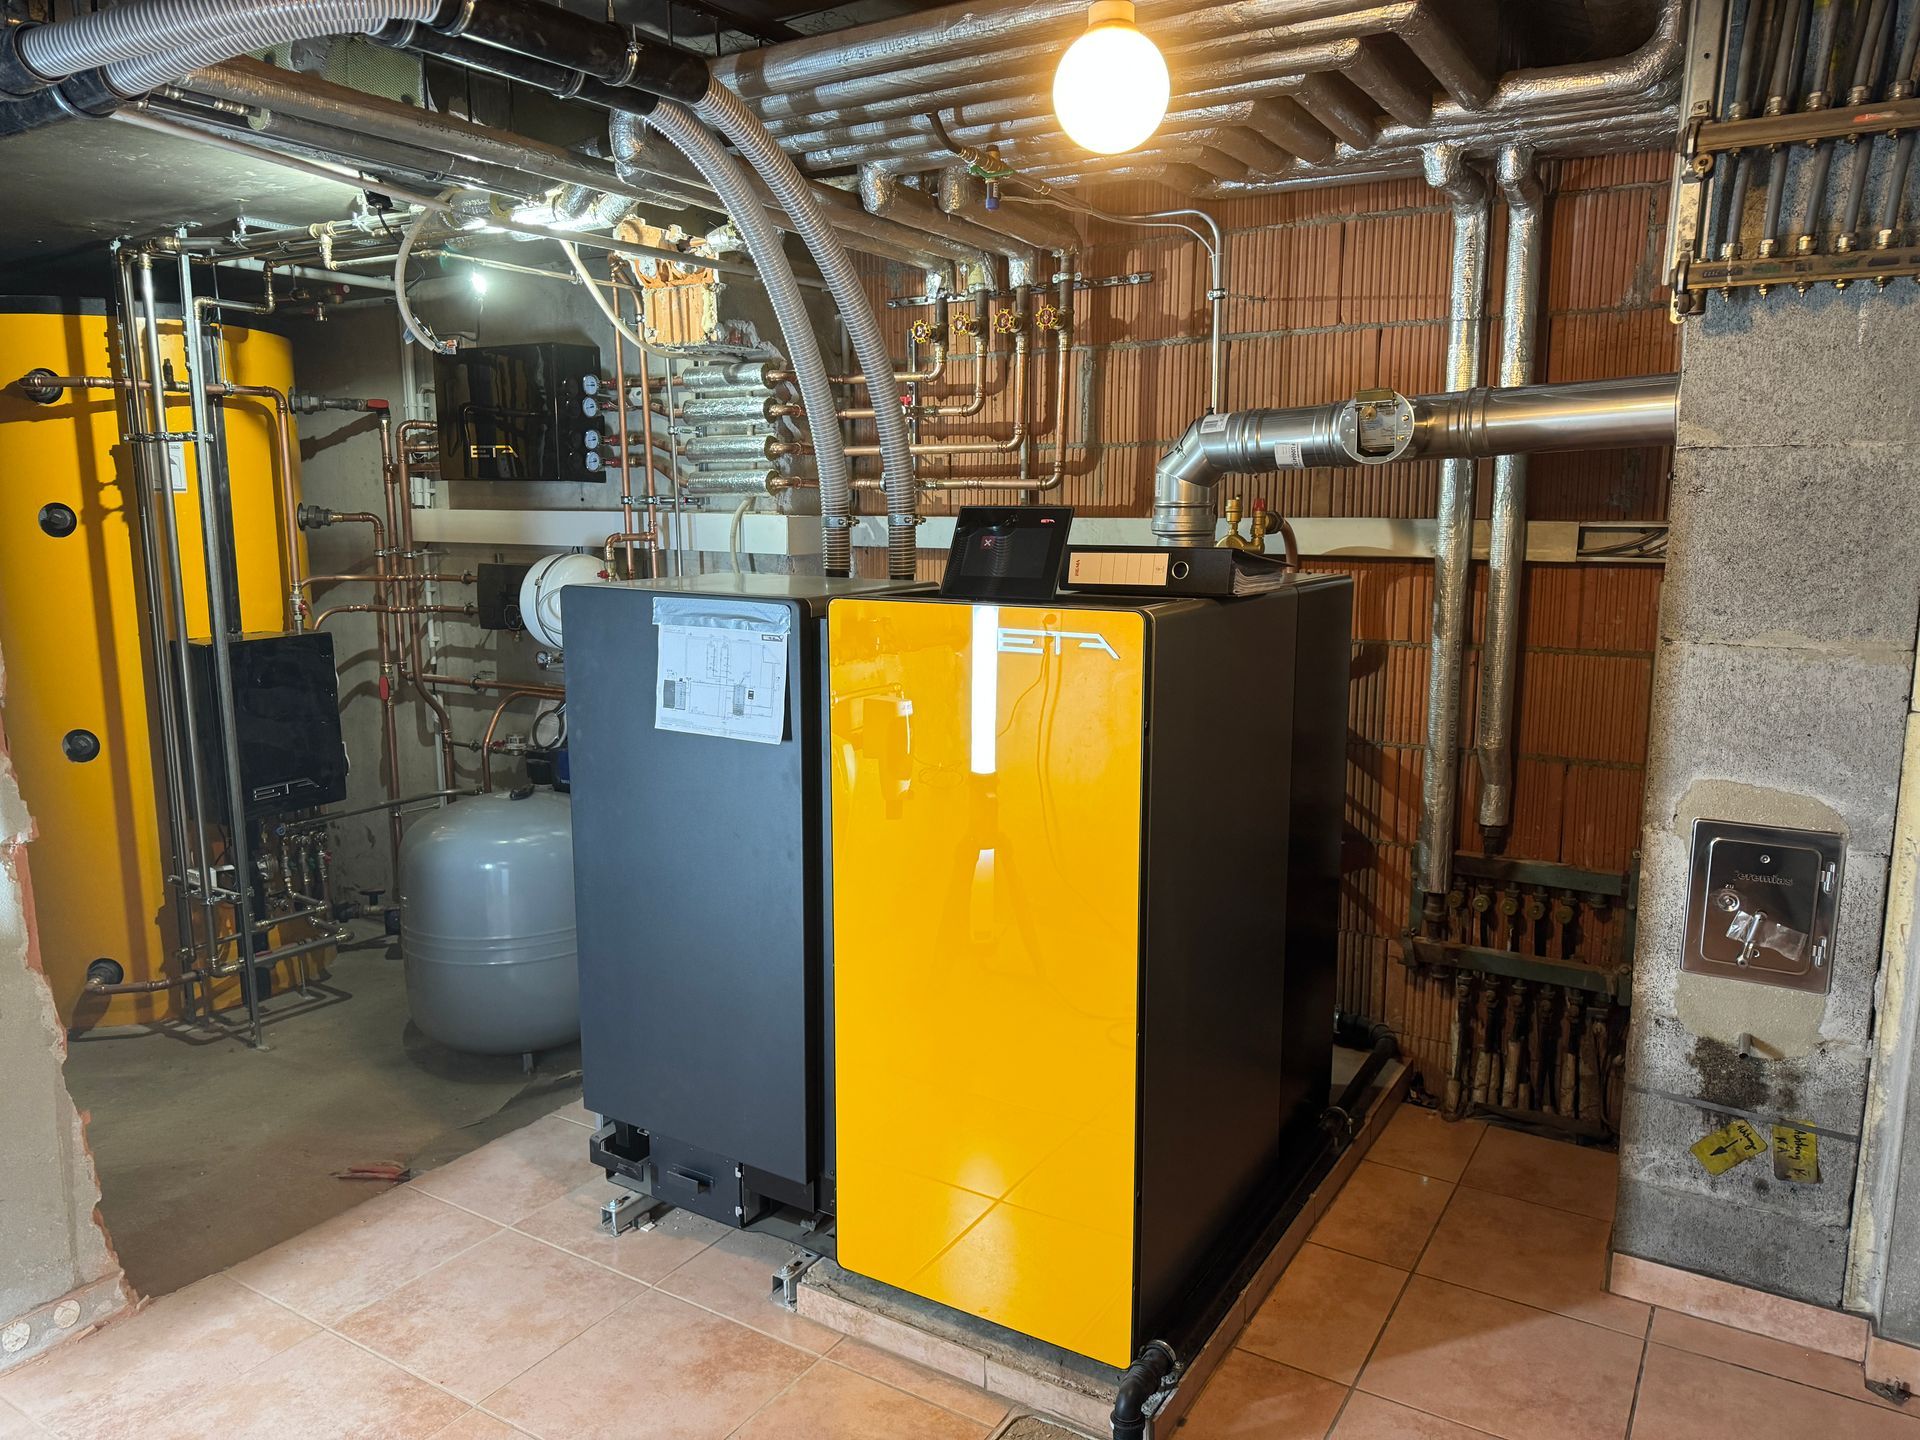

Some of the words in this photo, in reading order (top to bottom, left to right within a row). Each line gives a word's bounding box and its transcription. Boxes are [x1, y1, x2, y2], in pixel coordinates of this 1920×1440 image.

[470, 445, 518, 458] ETA
[997, 628, 1121, 660] ETA
[253, 778, 319, 801] ETA
